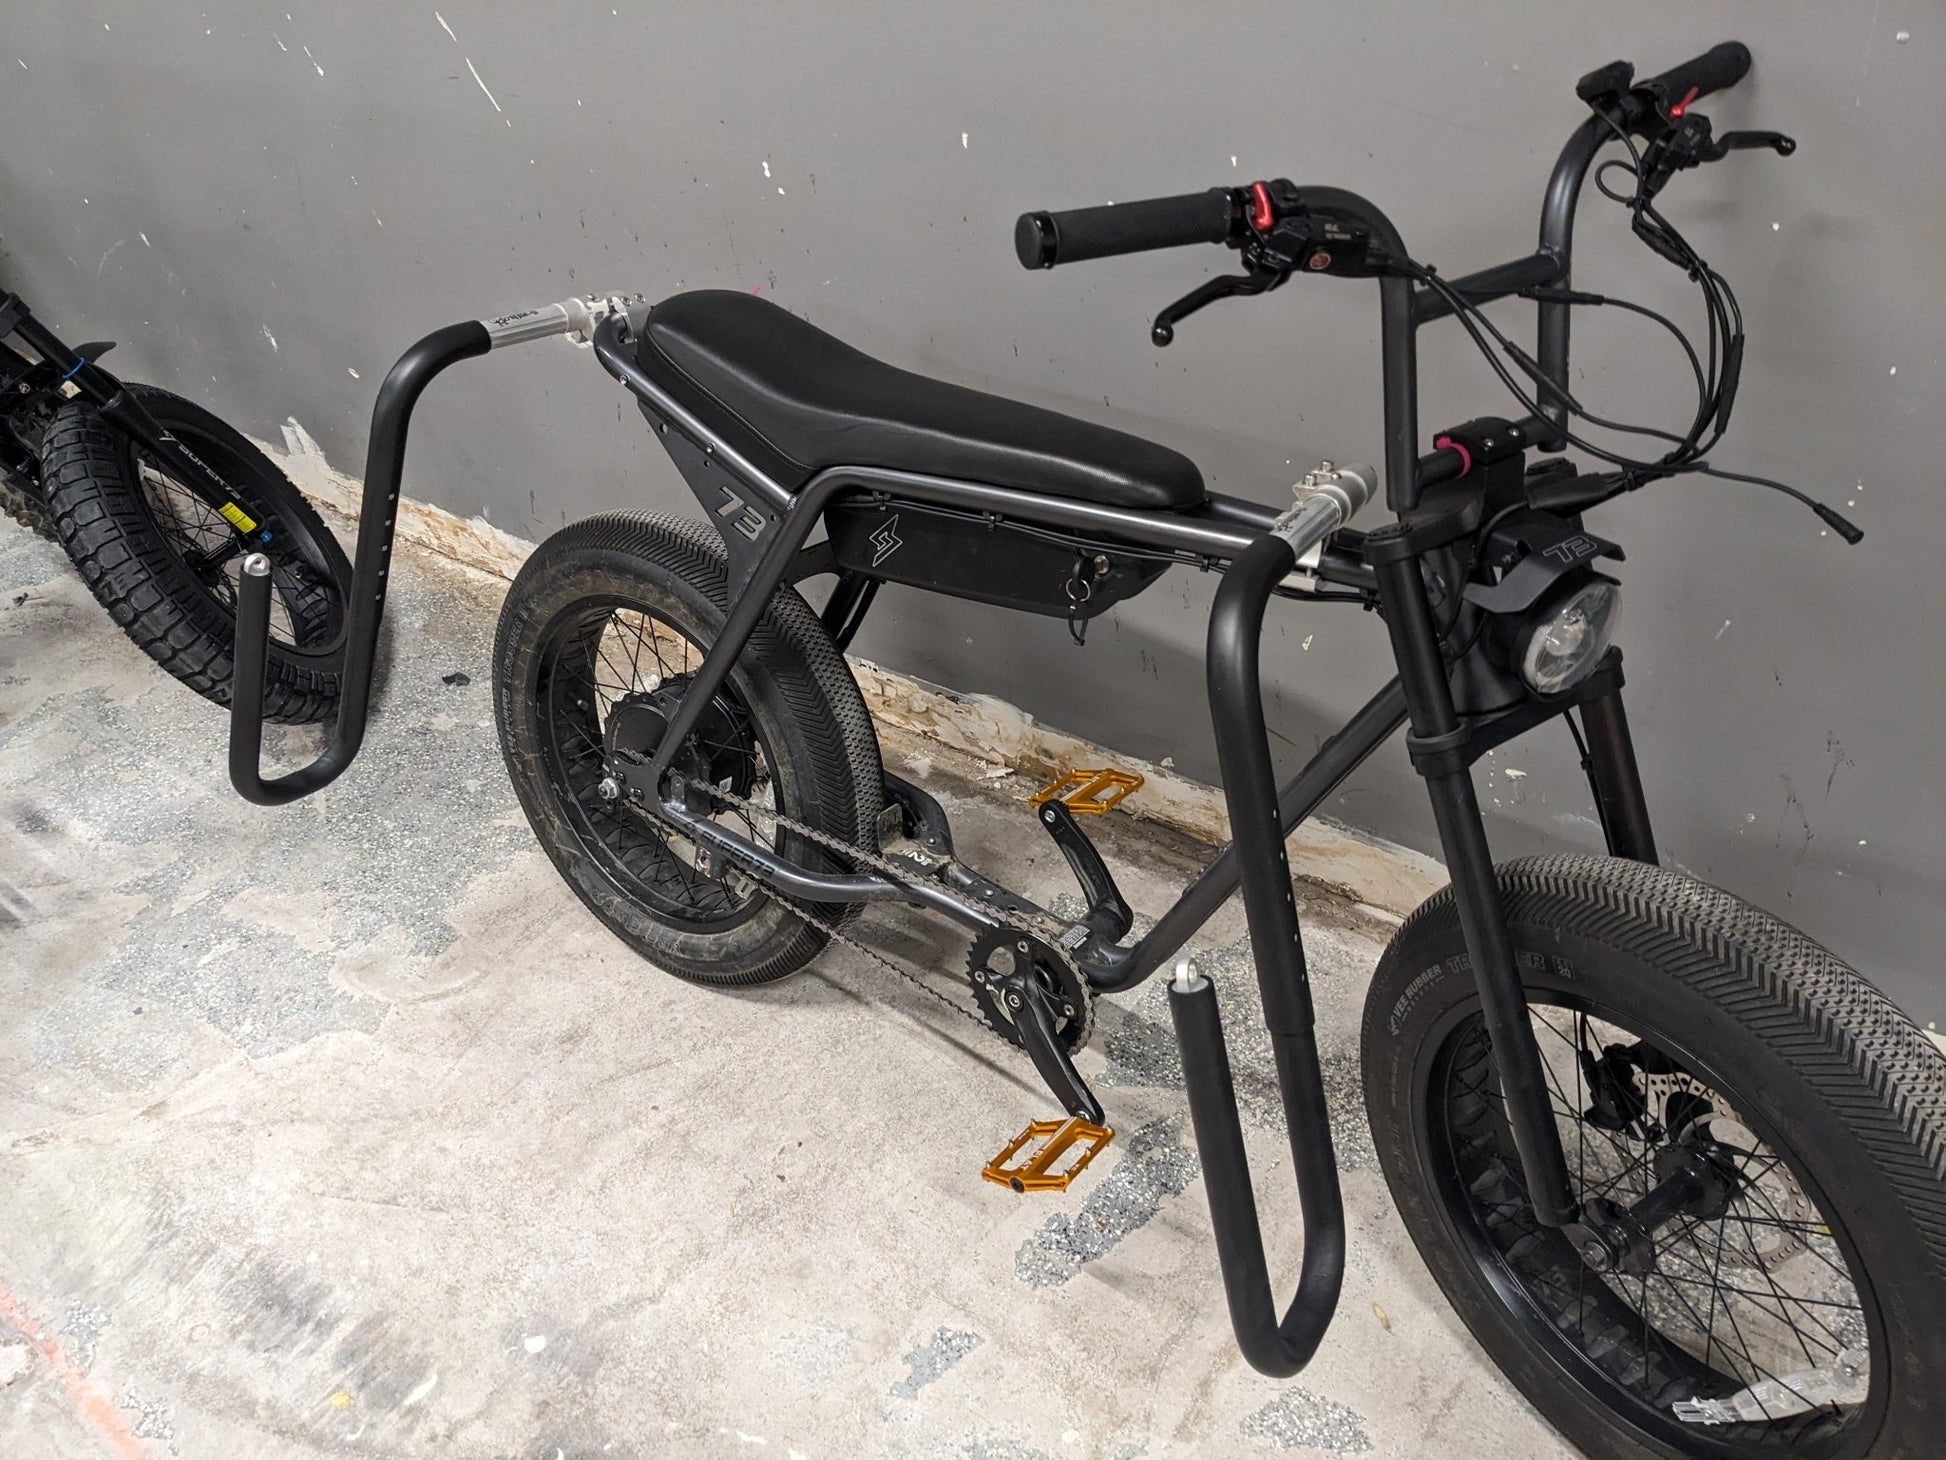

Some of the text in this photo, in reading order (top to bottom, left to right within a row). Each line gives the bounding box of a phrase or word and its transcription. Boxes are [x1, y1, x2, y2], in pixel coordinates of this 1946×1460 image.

[178, 443, 242, 500] SUPER73
[714, 486, 767, 542] 73
[1542, 535, 1598, 563] 73
[700, 830, 775, 877] SUPER73
[1446, 950, 1546, 974] TRER
[1393, 997, 1408, 1018] VEE
[1406, 963, 1443, 1001] RUBBER
